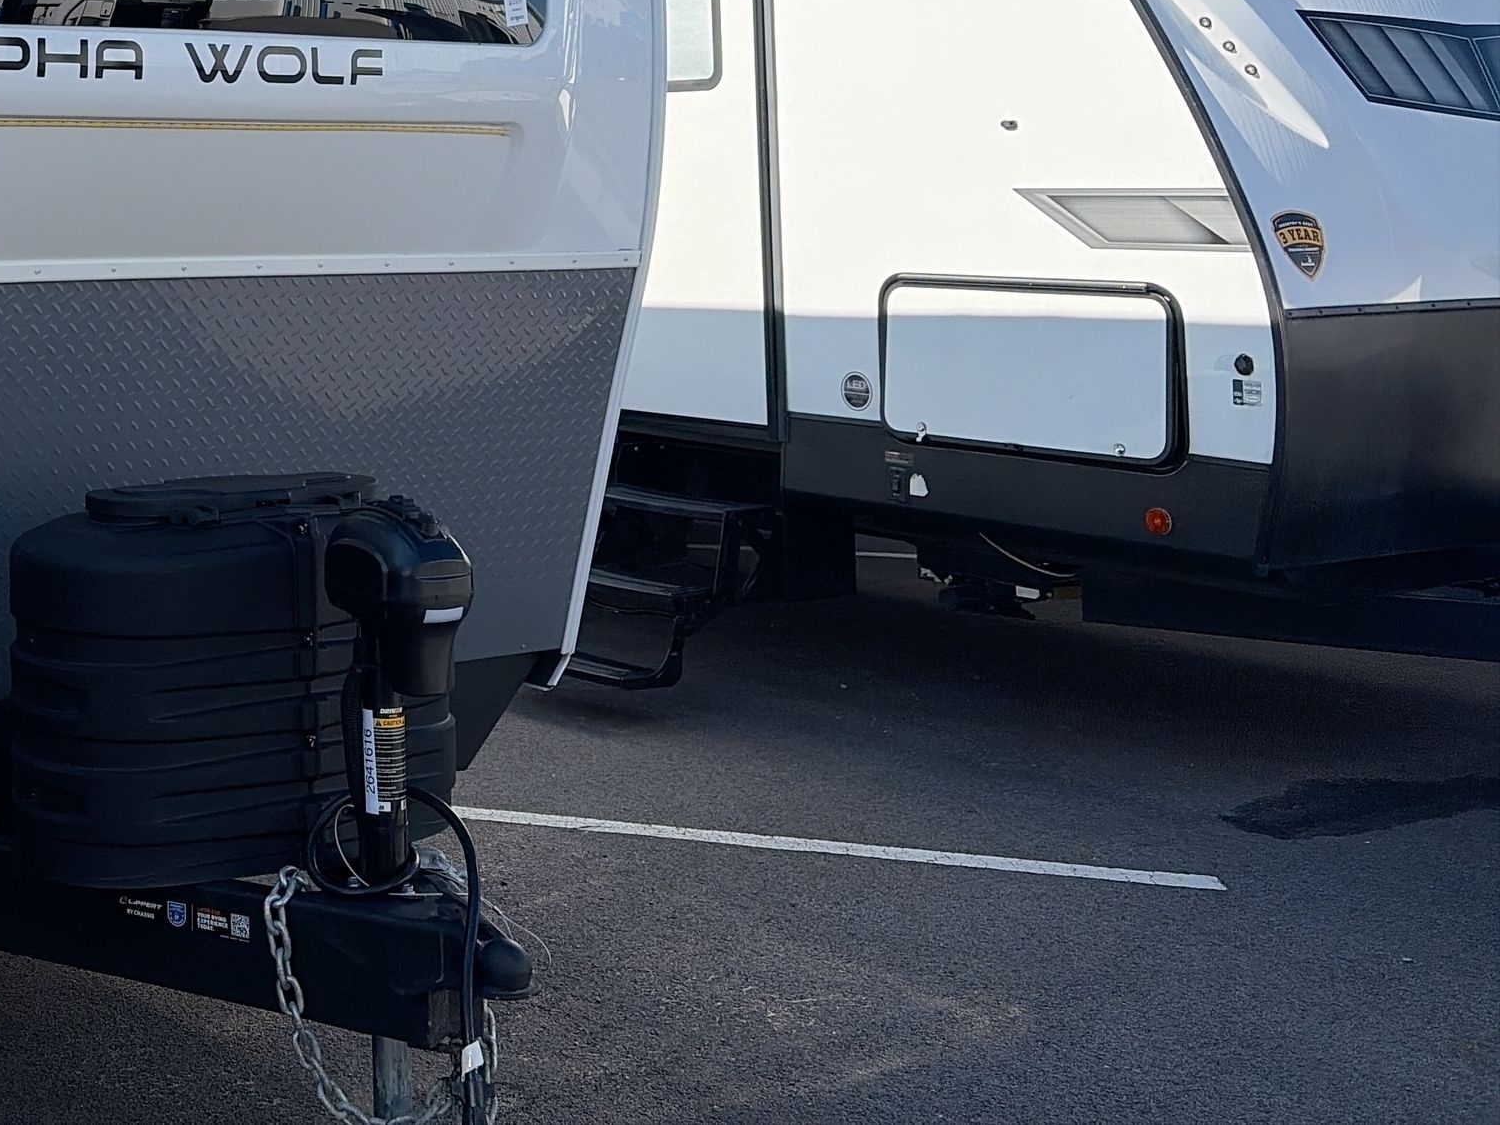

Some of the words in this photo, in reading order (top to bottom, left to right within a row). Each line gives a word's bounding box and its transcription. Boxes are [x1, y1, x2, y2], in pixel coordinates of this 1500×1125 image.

[185, 41, 385, 87] WOLF
[1279, 231, 1288, 245] 3
[1287, 228, 1320, 243] YEAR
[846, 378, 867, 390] LED
[364, 728, 376, 795] 2641616
